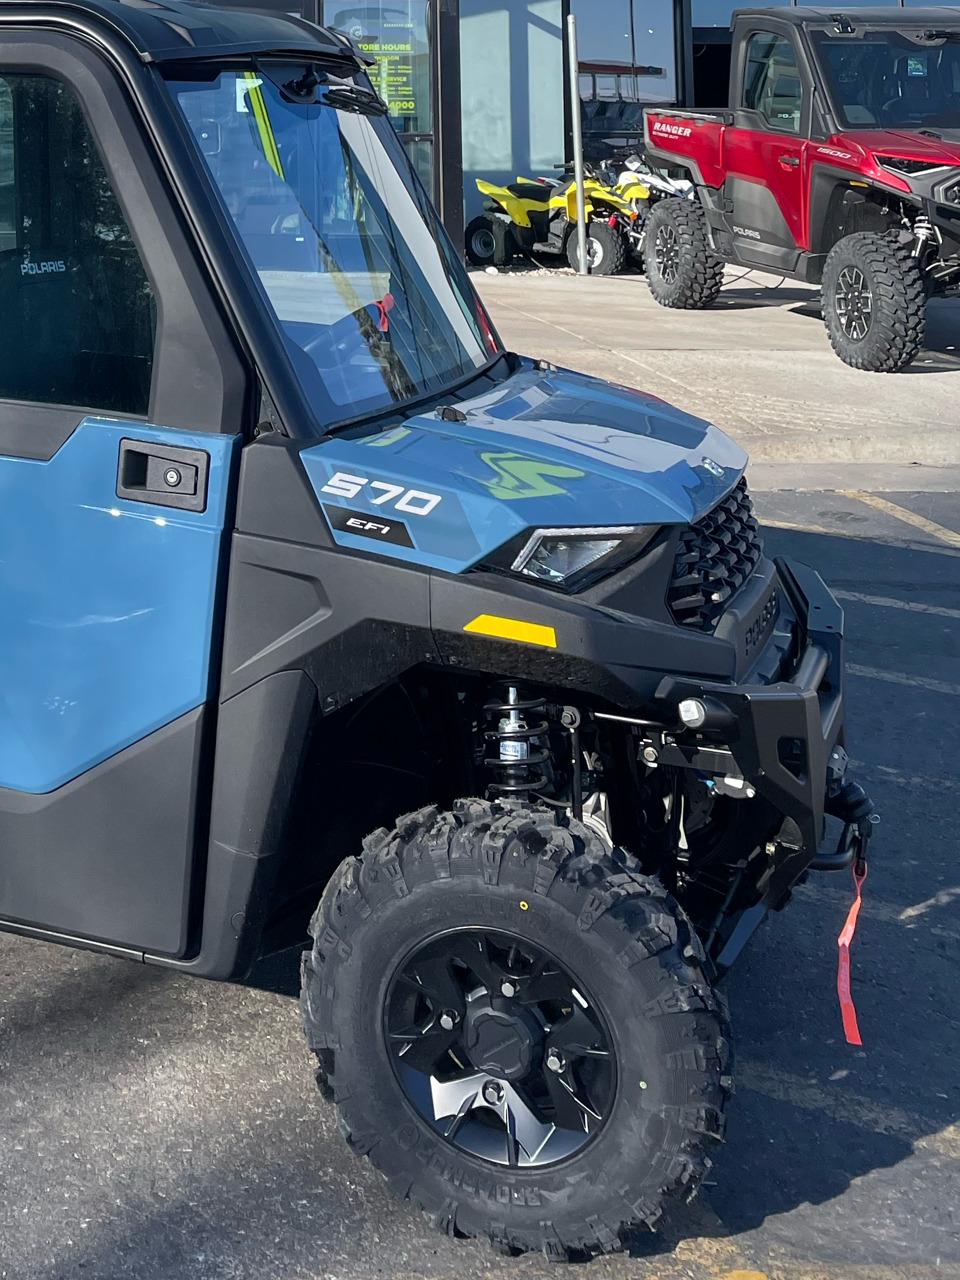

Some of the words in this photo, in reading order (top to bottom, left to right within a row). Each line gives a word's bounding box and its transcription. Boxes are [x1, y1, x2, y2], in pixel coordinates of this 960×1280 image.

[358, 43, 380, 51] TORE
[381, 43, 411, 51] HOURS
[653, 122, 692, 137] RANGER
[817, 147, 852, 159] 1500
[732, 226, 761, 240] POLARIS
[20, 260, 66, 276] POLARIS
[321, 472, 442, 516] 570
[346, 518, 390, 535] EFI
